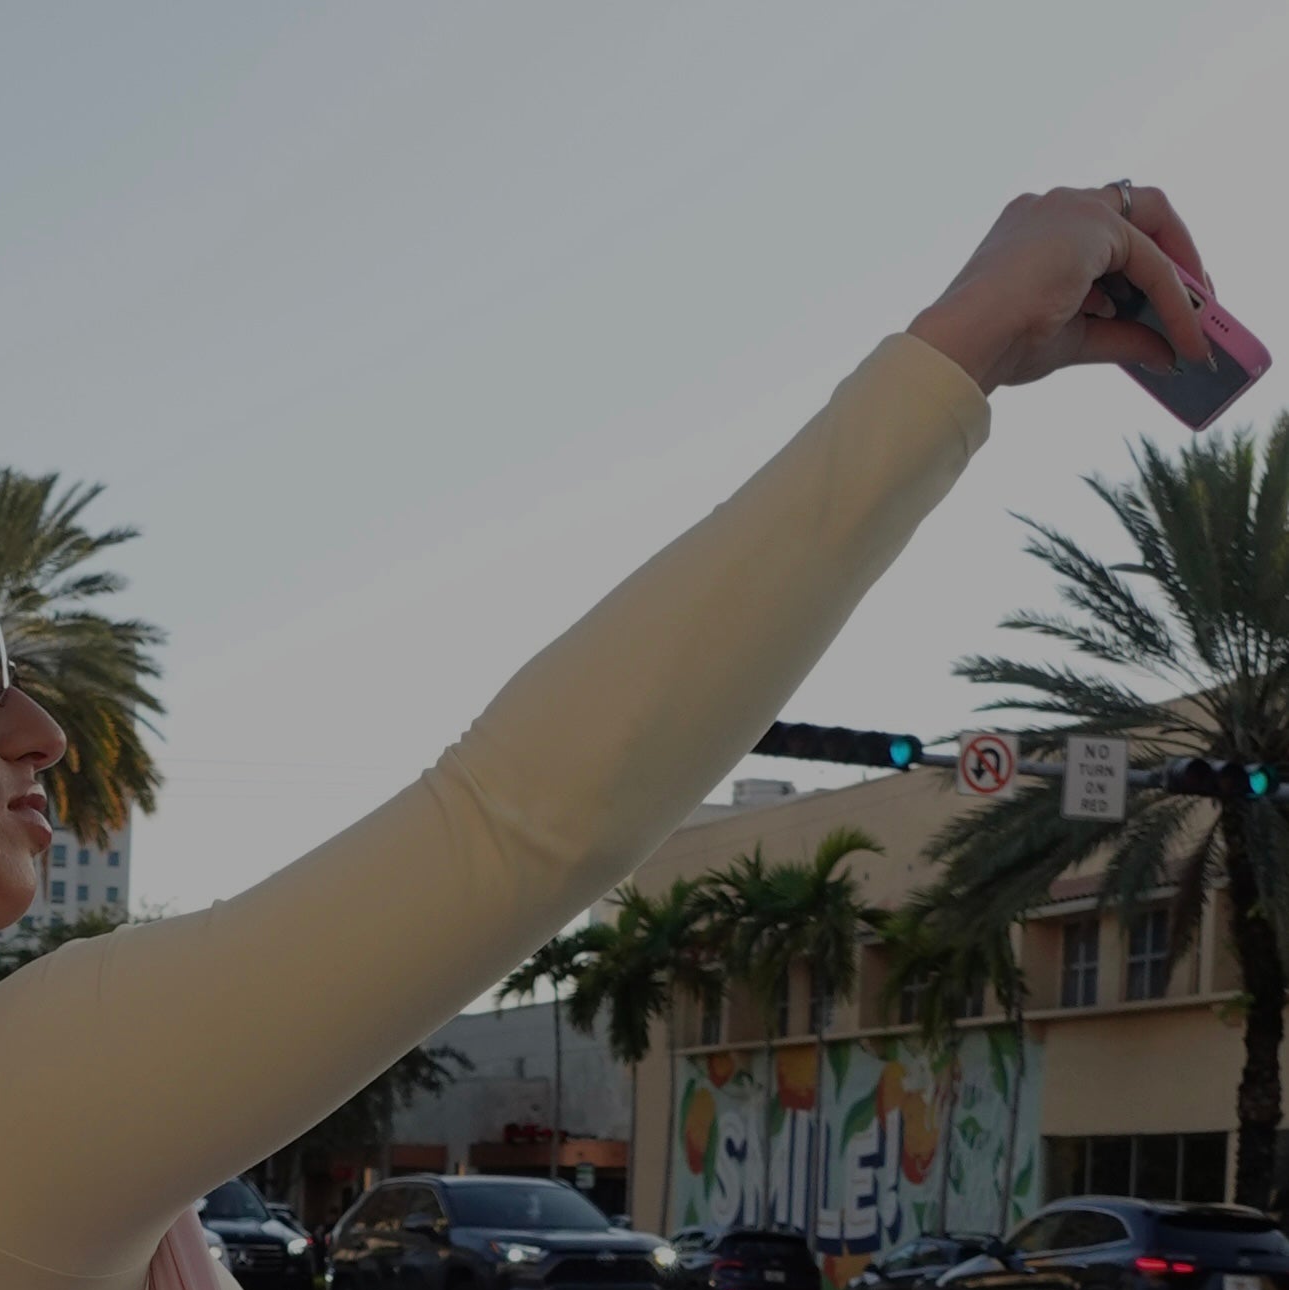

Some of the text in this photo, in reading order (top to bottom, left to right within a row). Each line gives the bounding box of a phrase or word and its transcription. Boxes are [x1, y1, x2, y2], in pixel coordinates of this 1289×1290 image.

[1084, 744, 1110, 761] NO
[1079, 763, 1115, 778] TURN
[1085, 781, 1107, 795] ON
[1081, 798, 1109, 812] RED
